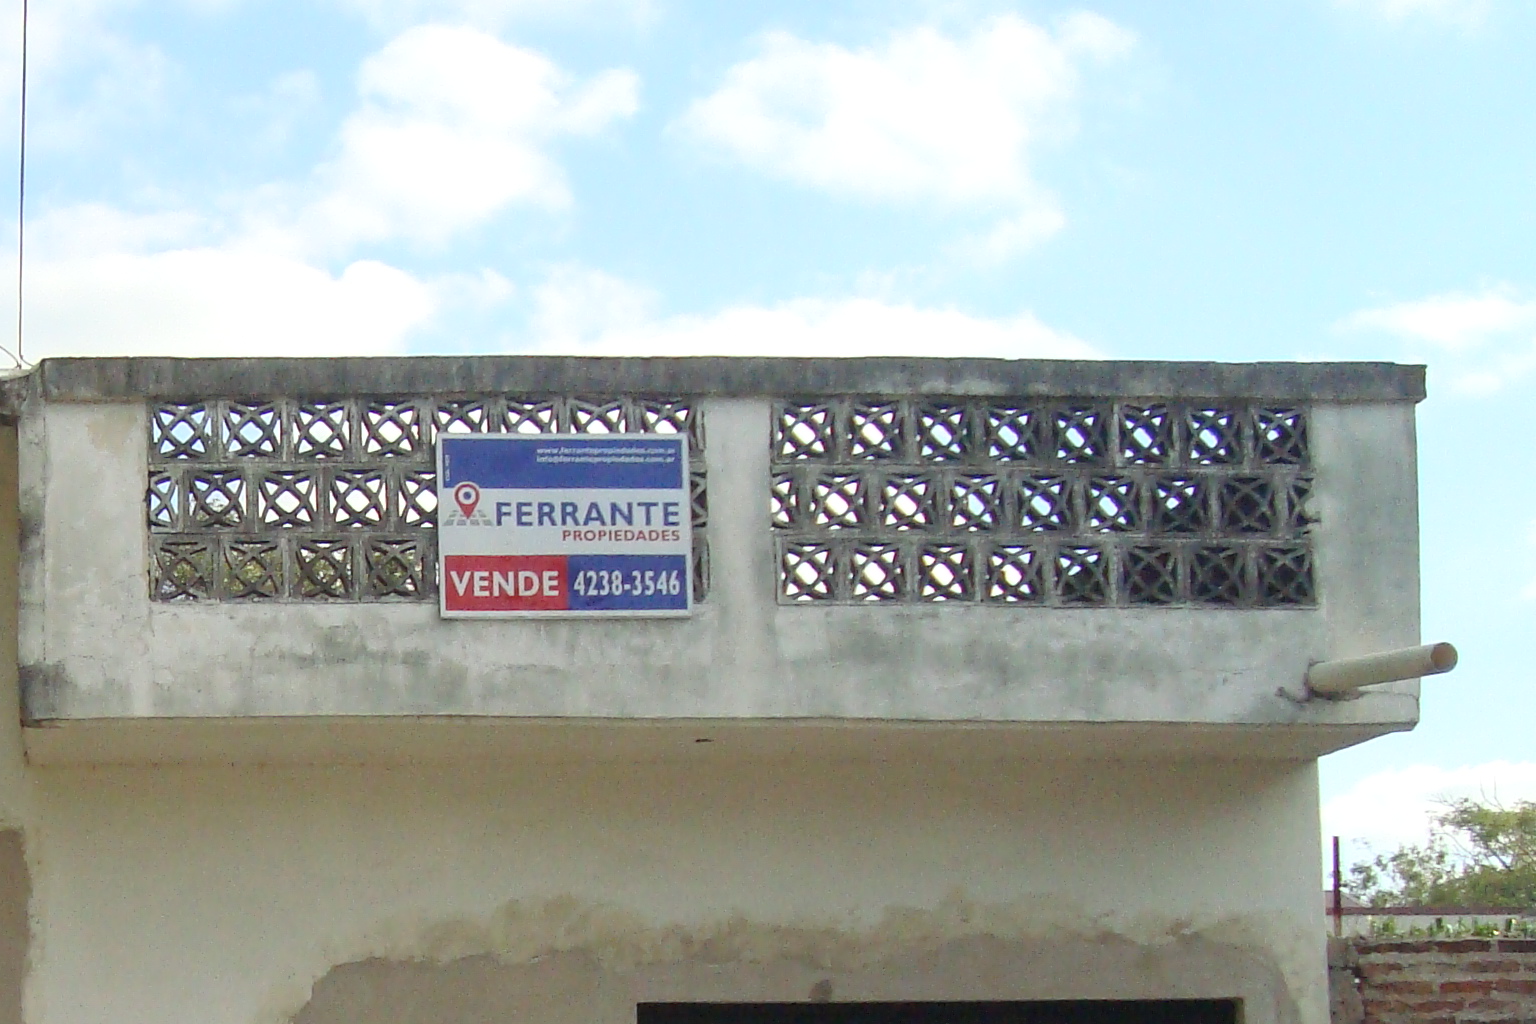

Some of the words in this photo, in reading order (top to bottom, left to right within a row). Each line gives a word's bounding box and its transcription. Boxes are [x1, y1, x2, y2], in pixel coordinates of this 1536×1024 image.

[496, 501, 681, 527] FERRANTE
[562, 529, 681, 542] PROPIEDADES
[450, 570, 560, 597] VENDE
[573, 569, 681, 596] 4238-3546
